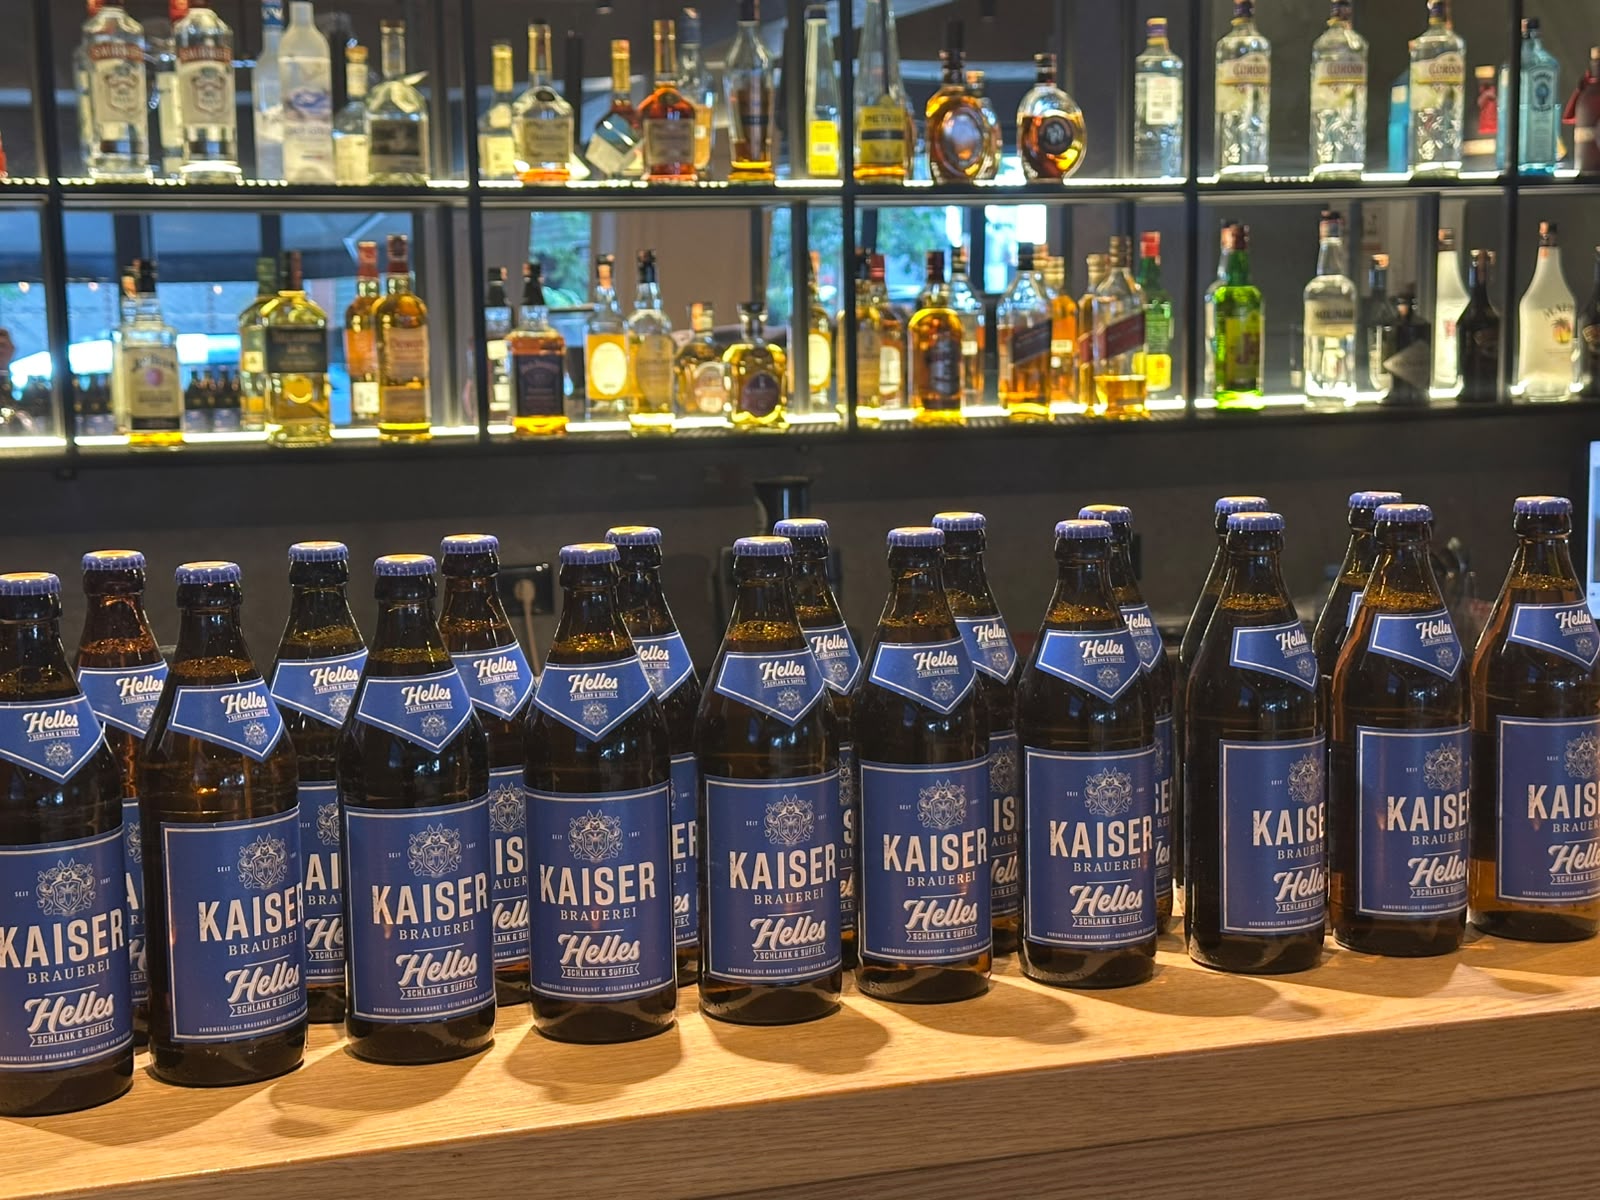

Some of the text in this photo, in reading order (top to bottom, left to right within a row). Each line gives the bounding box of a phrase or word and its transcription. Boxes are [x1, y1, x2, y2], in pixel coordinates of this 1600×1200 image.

[638, 645, 669, 661] elles
[810, 634, 848, 653] Helles
[1079, 639, 1124, 658] Helles
[473, 656, 517, 677] Helles
[759, 660, 806, 681] Helles
[913, 651, 958, 670] Helles
[310, 665, 358, 687] Helles
[567, 672, 618, 693] Helles
[220, 691, 267, 715] Helles
[401, 683, 451, 706] Helles
[23, 710, 78, 733] Helles
[1527, 780, 1600, 820] KAIS
[1252, 801, 1325, 846] KAISE
[1049, 815, 1153, 858] KAISER
[883, 827, 987, 872] KAISER
[729, 842, 837, 890] KAISER
[1073, 859, 1141, 873] BRAUEREI
[539, 861, 657, 906] KAISER
[907, 871, 976, 887] BRAUEREI
[371, 872, 488, 925] KAISER
[753, 888, 824, 905] BRAUEREI
[1069, 884, 1143, 917] Helles
[198, 881, 304, 942] KAISER
[560, 907, 637, 921] BRAUEREI
[903, 898, 978, 932] Helles
[0, 908, 124, 968] KAISER
[399, 919, 475, 941] BRAUEREI
[750, 915, 826, 950] Helles
[228, 931, 297, 956] BRAUEREI
[557, 934, 641, 968] Helles
[760, 950, 792, 960] SCHLANK
[27, 958, 110, 984] BRAUEREI
[395, 949, 478, 988] Helles
[566, 968, 599, 977] SCHLANK
[224, 961, 300, 1003] Helles
[406, 987, 441, 998] SCHLANK
[24, 991, 114, 1033] Helles
[236, 1001, 271, 1014] SCHLANK
[37, 1031, 75, 1044] SCHLANK
